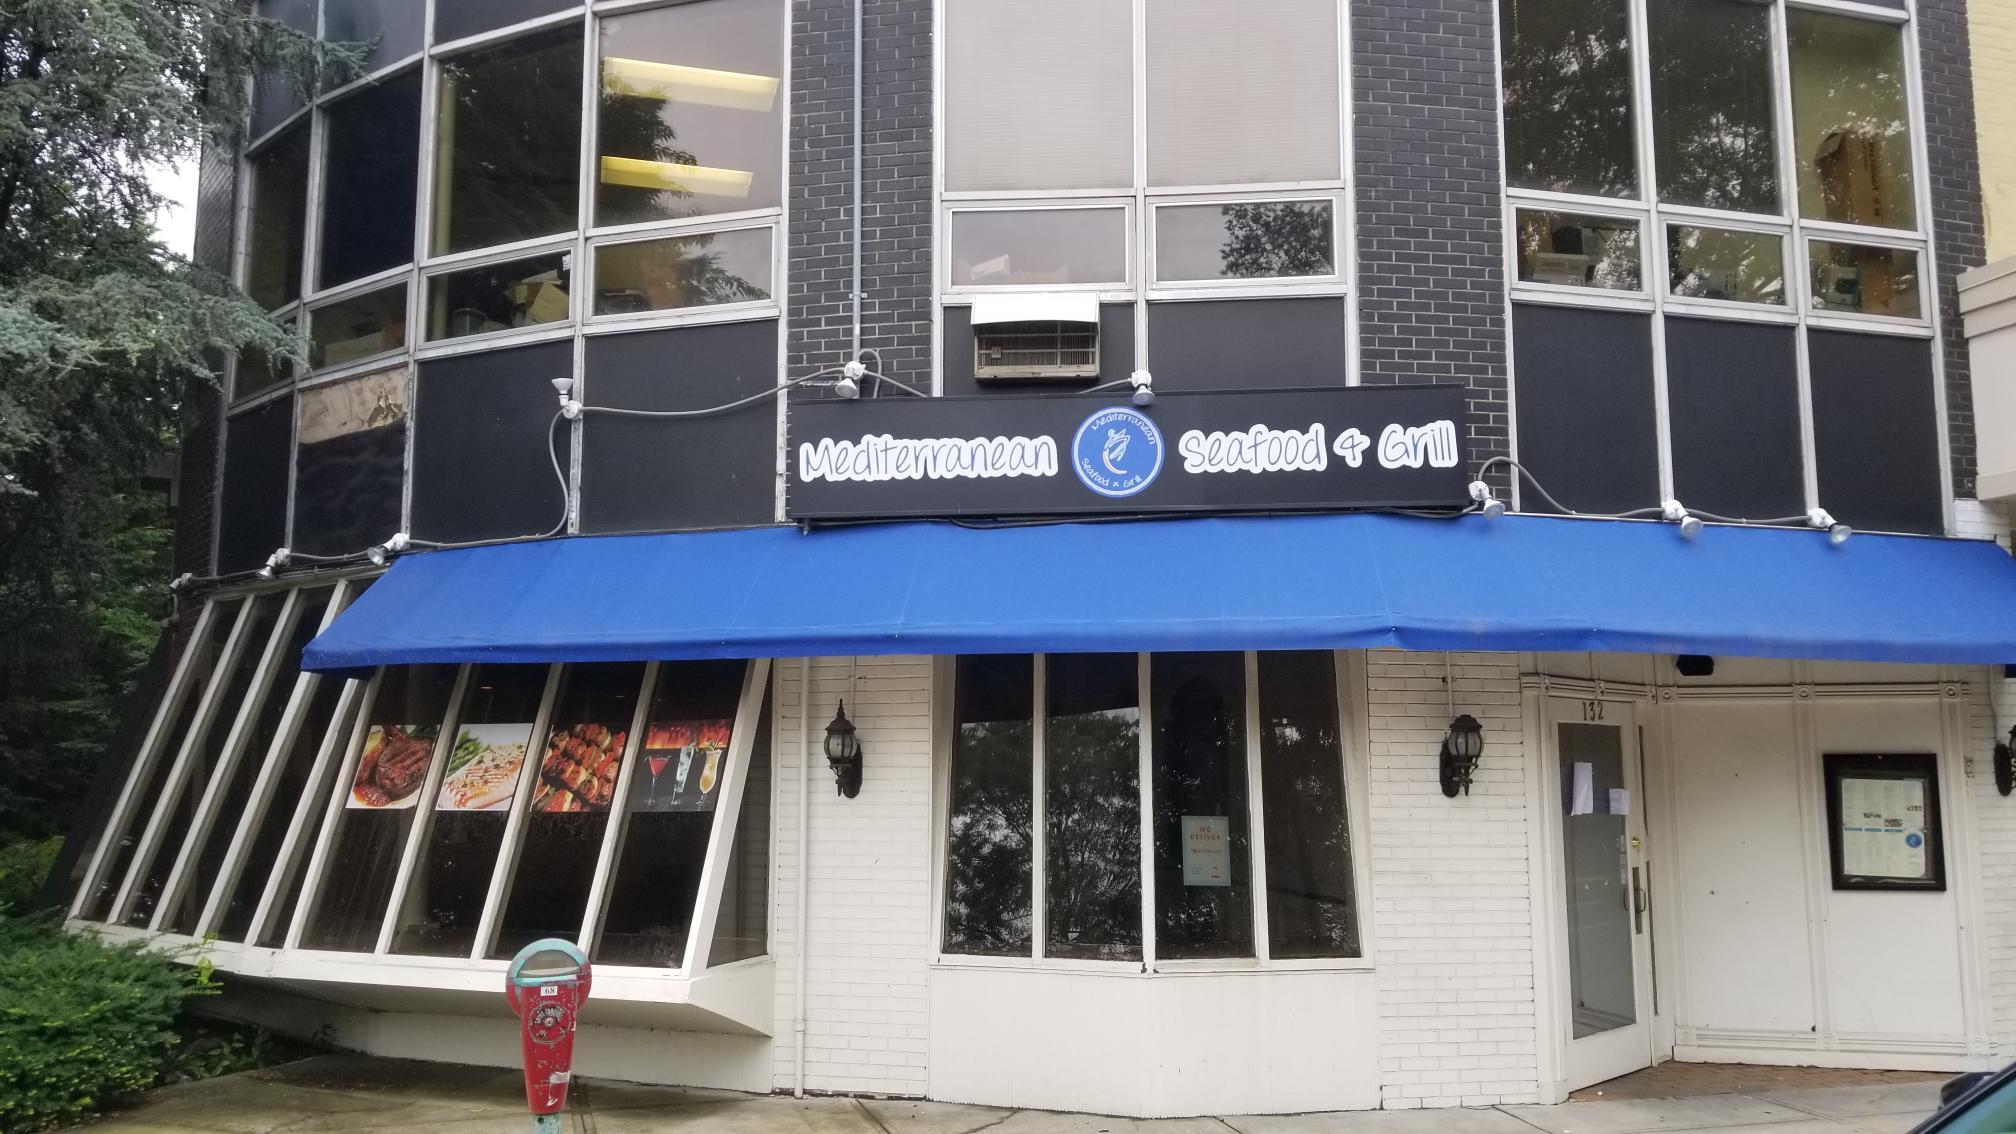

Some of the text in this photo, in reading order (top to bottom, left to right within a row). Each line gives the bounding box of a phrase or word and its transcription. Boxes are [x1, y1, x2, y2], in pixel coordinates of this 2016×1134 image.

[1091, 413, 1156, 445] Mediterranean
[800, 434, 1058, 482] Mediterranean
[1179, 423, 1327, 473] Seafood
[1378, 420, 1458, 469] Grill
[1082, 458, 1110, 487] Seafood
[1582, 701, 1604, 721] 132
